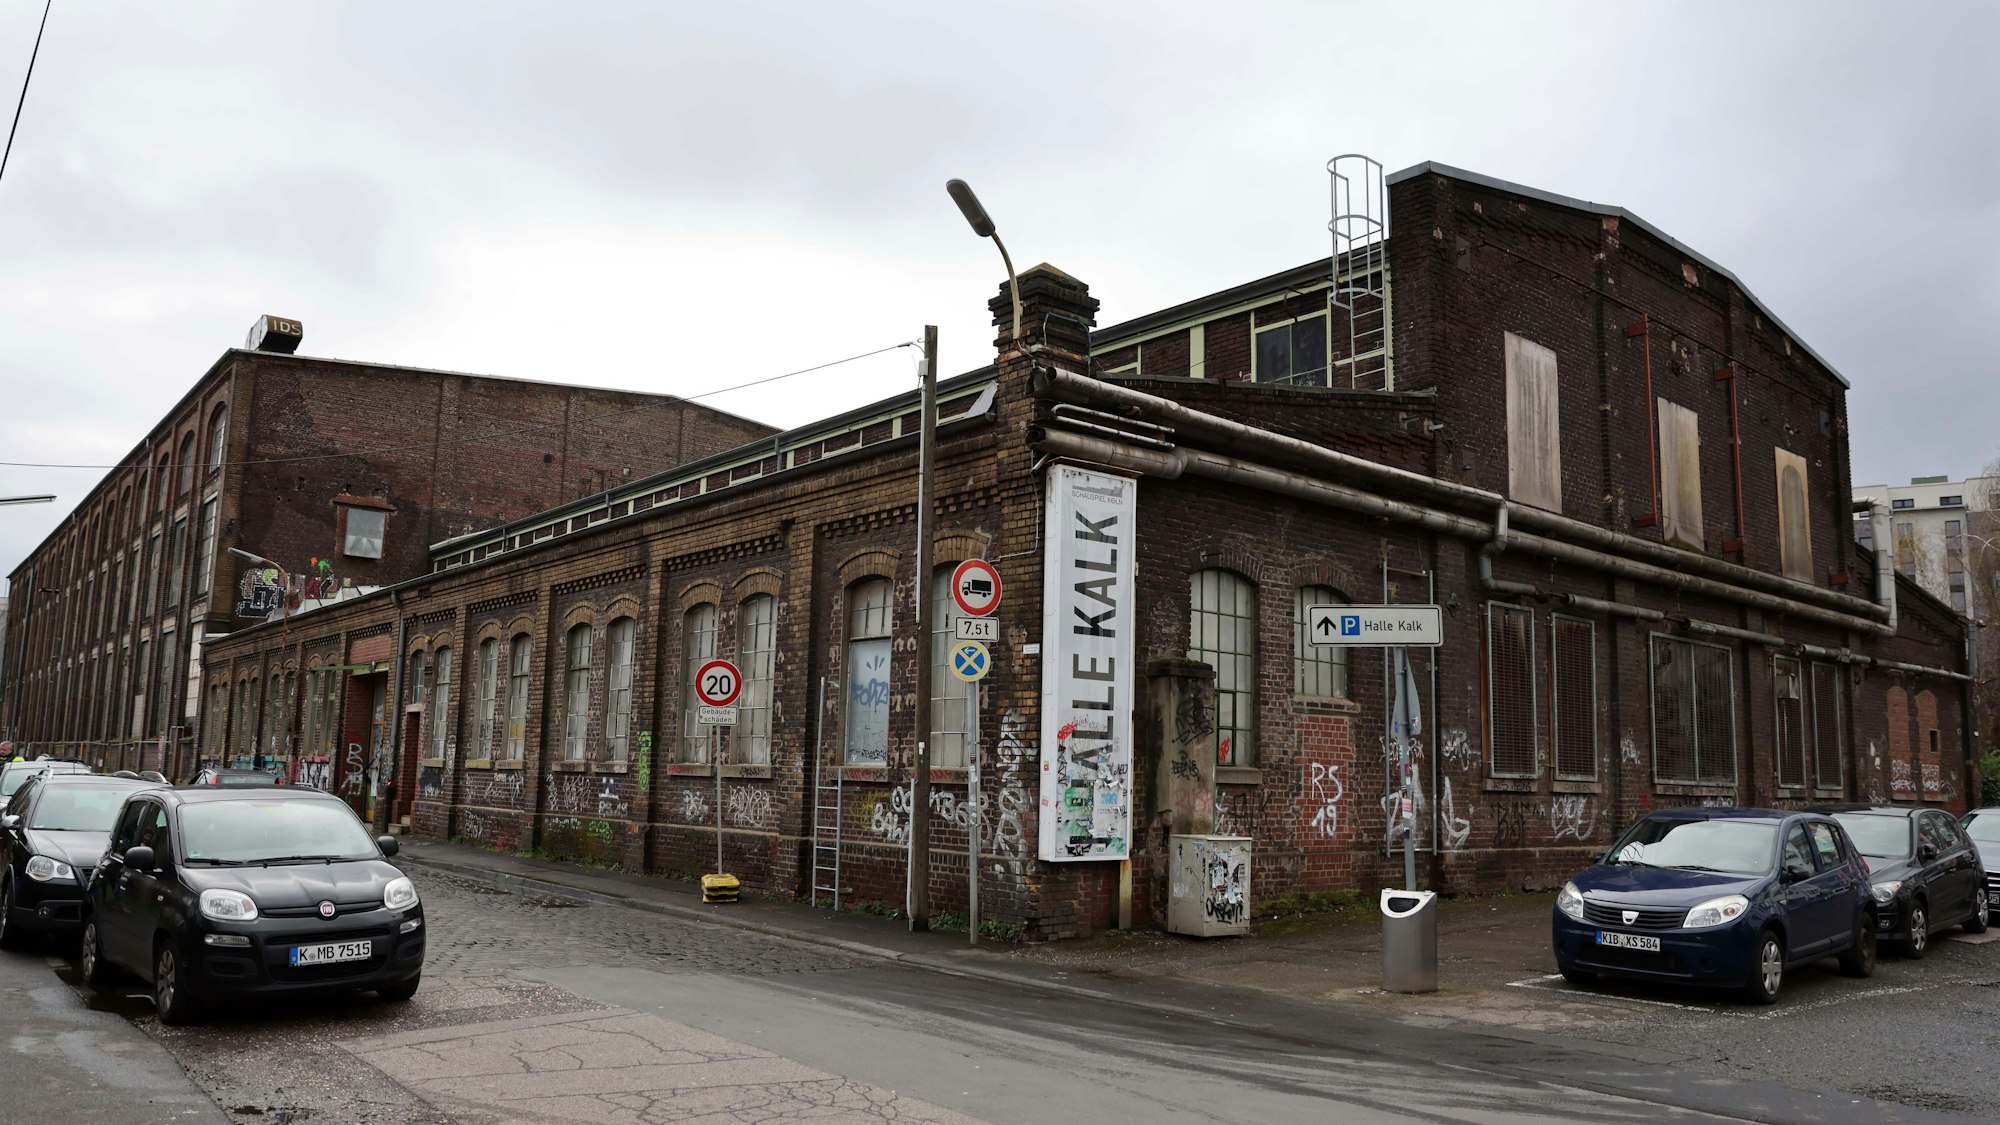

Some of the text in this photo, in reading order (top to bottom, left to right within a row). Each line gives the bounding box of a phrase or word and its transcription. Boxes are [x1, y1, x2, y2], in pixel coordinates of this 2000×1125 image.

[273, 319, 301, 335] IDS
[1073, 510, 1118, 638] KALK
[1364, 620, 1394, 632] Halle
[1398, 620, 1423, 632] Kalk
[706, 675, 731, 695] 20
[1311, 762, 1343, 803] RS
[1311, 804, 1338, 838] 19
[1602, 933, 1658, 949] KIB XS 584
[299, 942, 370, 961] K MB 7515
